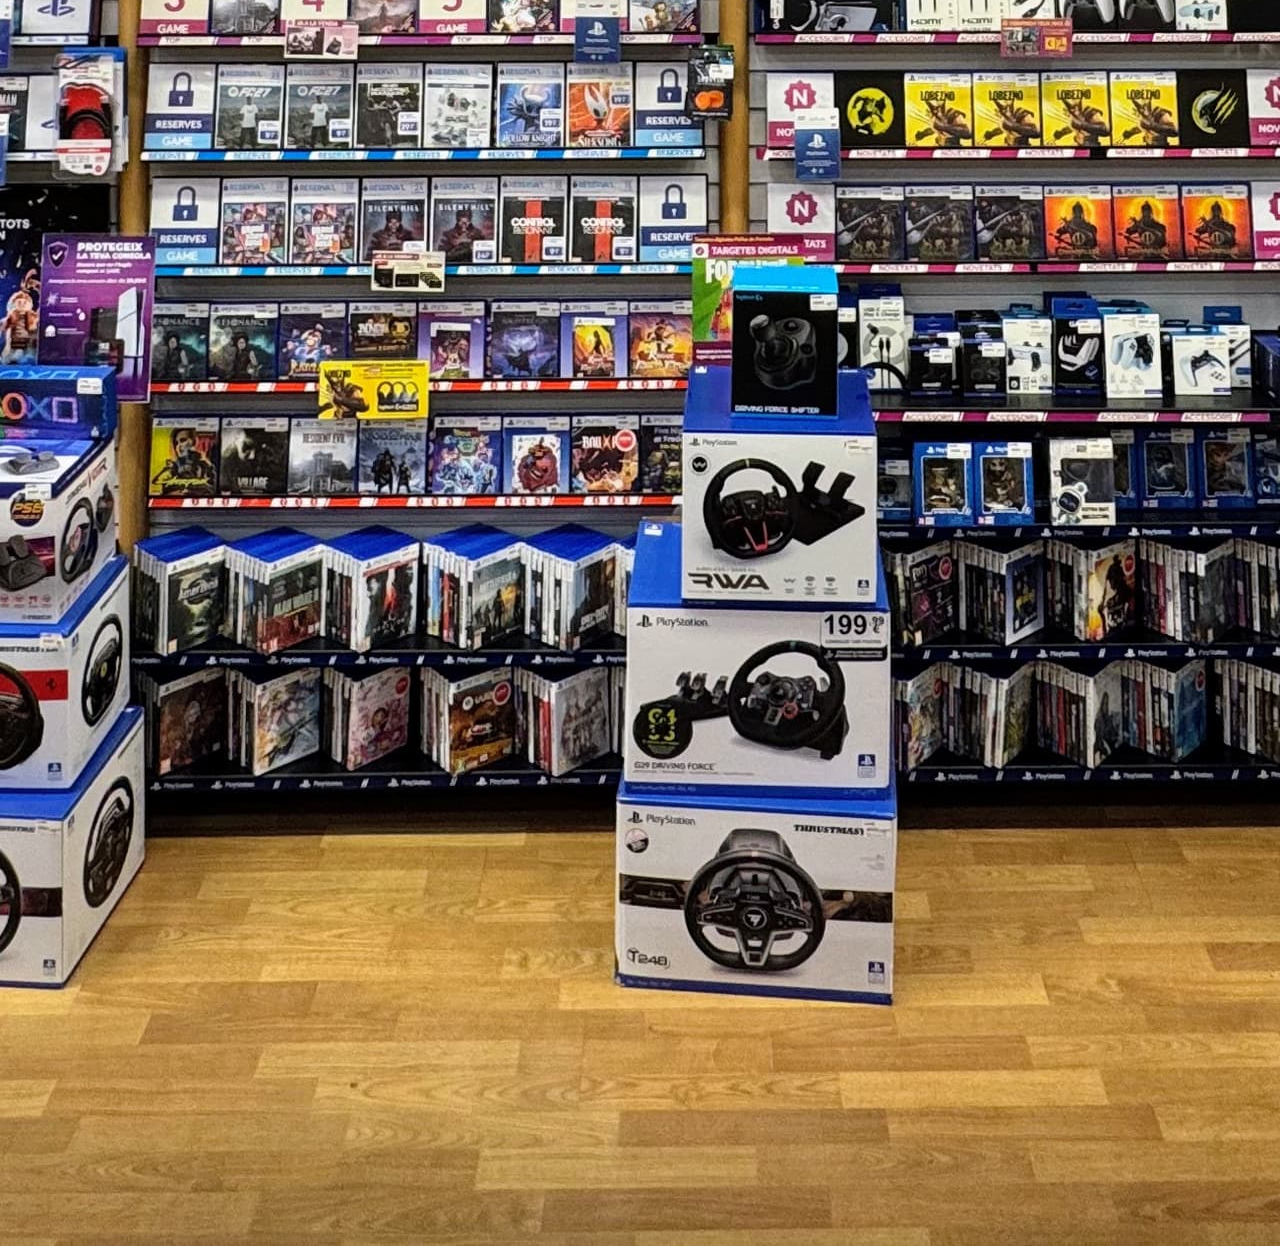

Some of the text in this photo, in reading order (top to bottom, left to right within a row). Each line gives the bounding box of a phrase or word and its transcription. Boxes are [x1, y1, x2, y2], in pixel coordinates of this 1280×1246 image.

[239, 87, 272, 98] FC27
[920, 91, 955, 101] LOBEZNO
[989, 91, 1024, 101] LOBEZNO
[155, 120, 202, 130] RESERVES
[646, 116, 692, 125] RESERVES
[162, 137, 192, 146] GAME
[653, 133, 684, 143] GAME
[368, 204, 421, 213] SILENT HILL
[0, 219, 30, 229] TOTS
[510, 217, 556, 228] CONTROL
[580, 217, 625, 227] CONTROL
[160, 235, 207, 244] RESERVES
[77, 242, 143, 252] PROTEGEIX
[711, 245, 798, 255] TARGETES DIGITALS
[77, 252, 151, 262] LA TEVA CONSOLA
[765, 406, 788, 414] FORCE
[656, 617, 709, 628] PlayStation
[634, 762, 715, 771] G29 DRIVING FORCE
[646, 814, 696, 827] PlayStation
